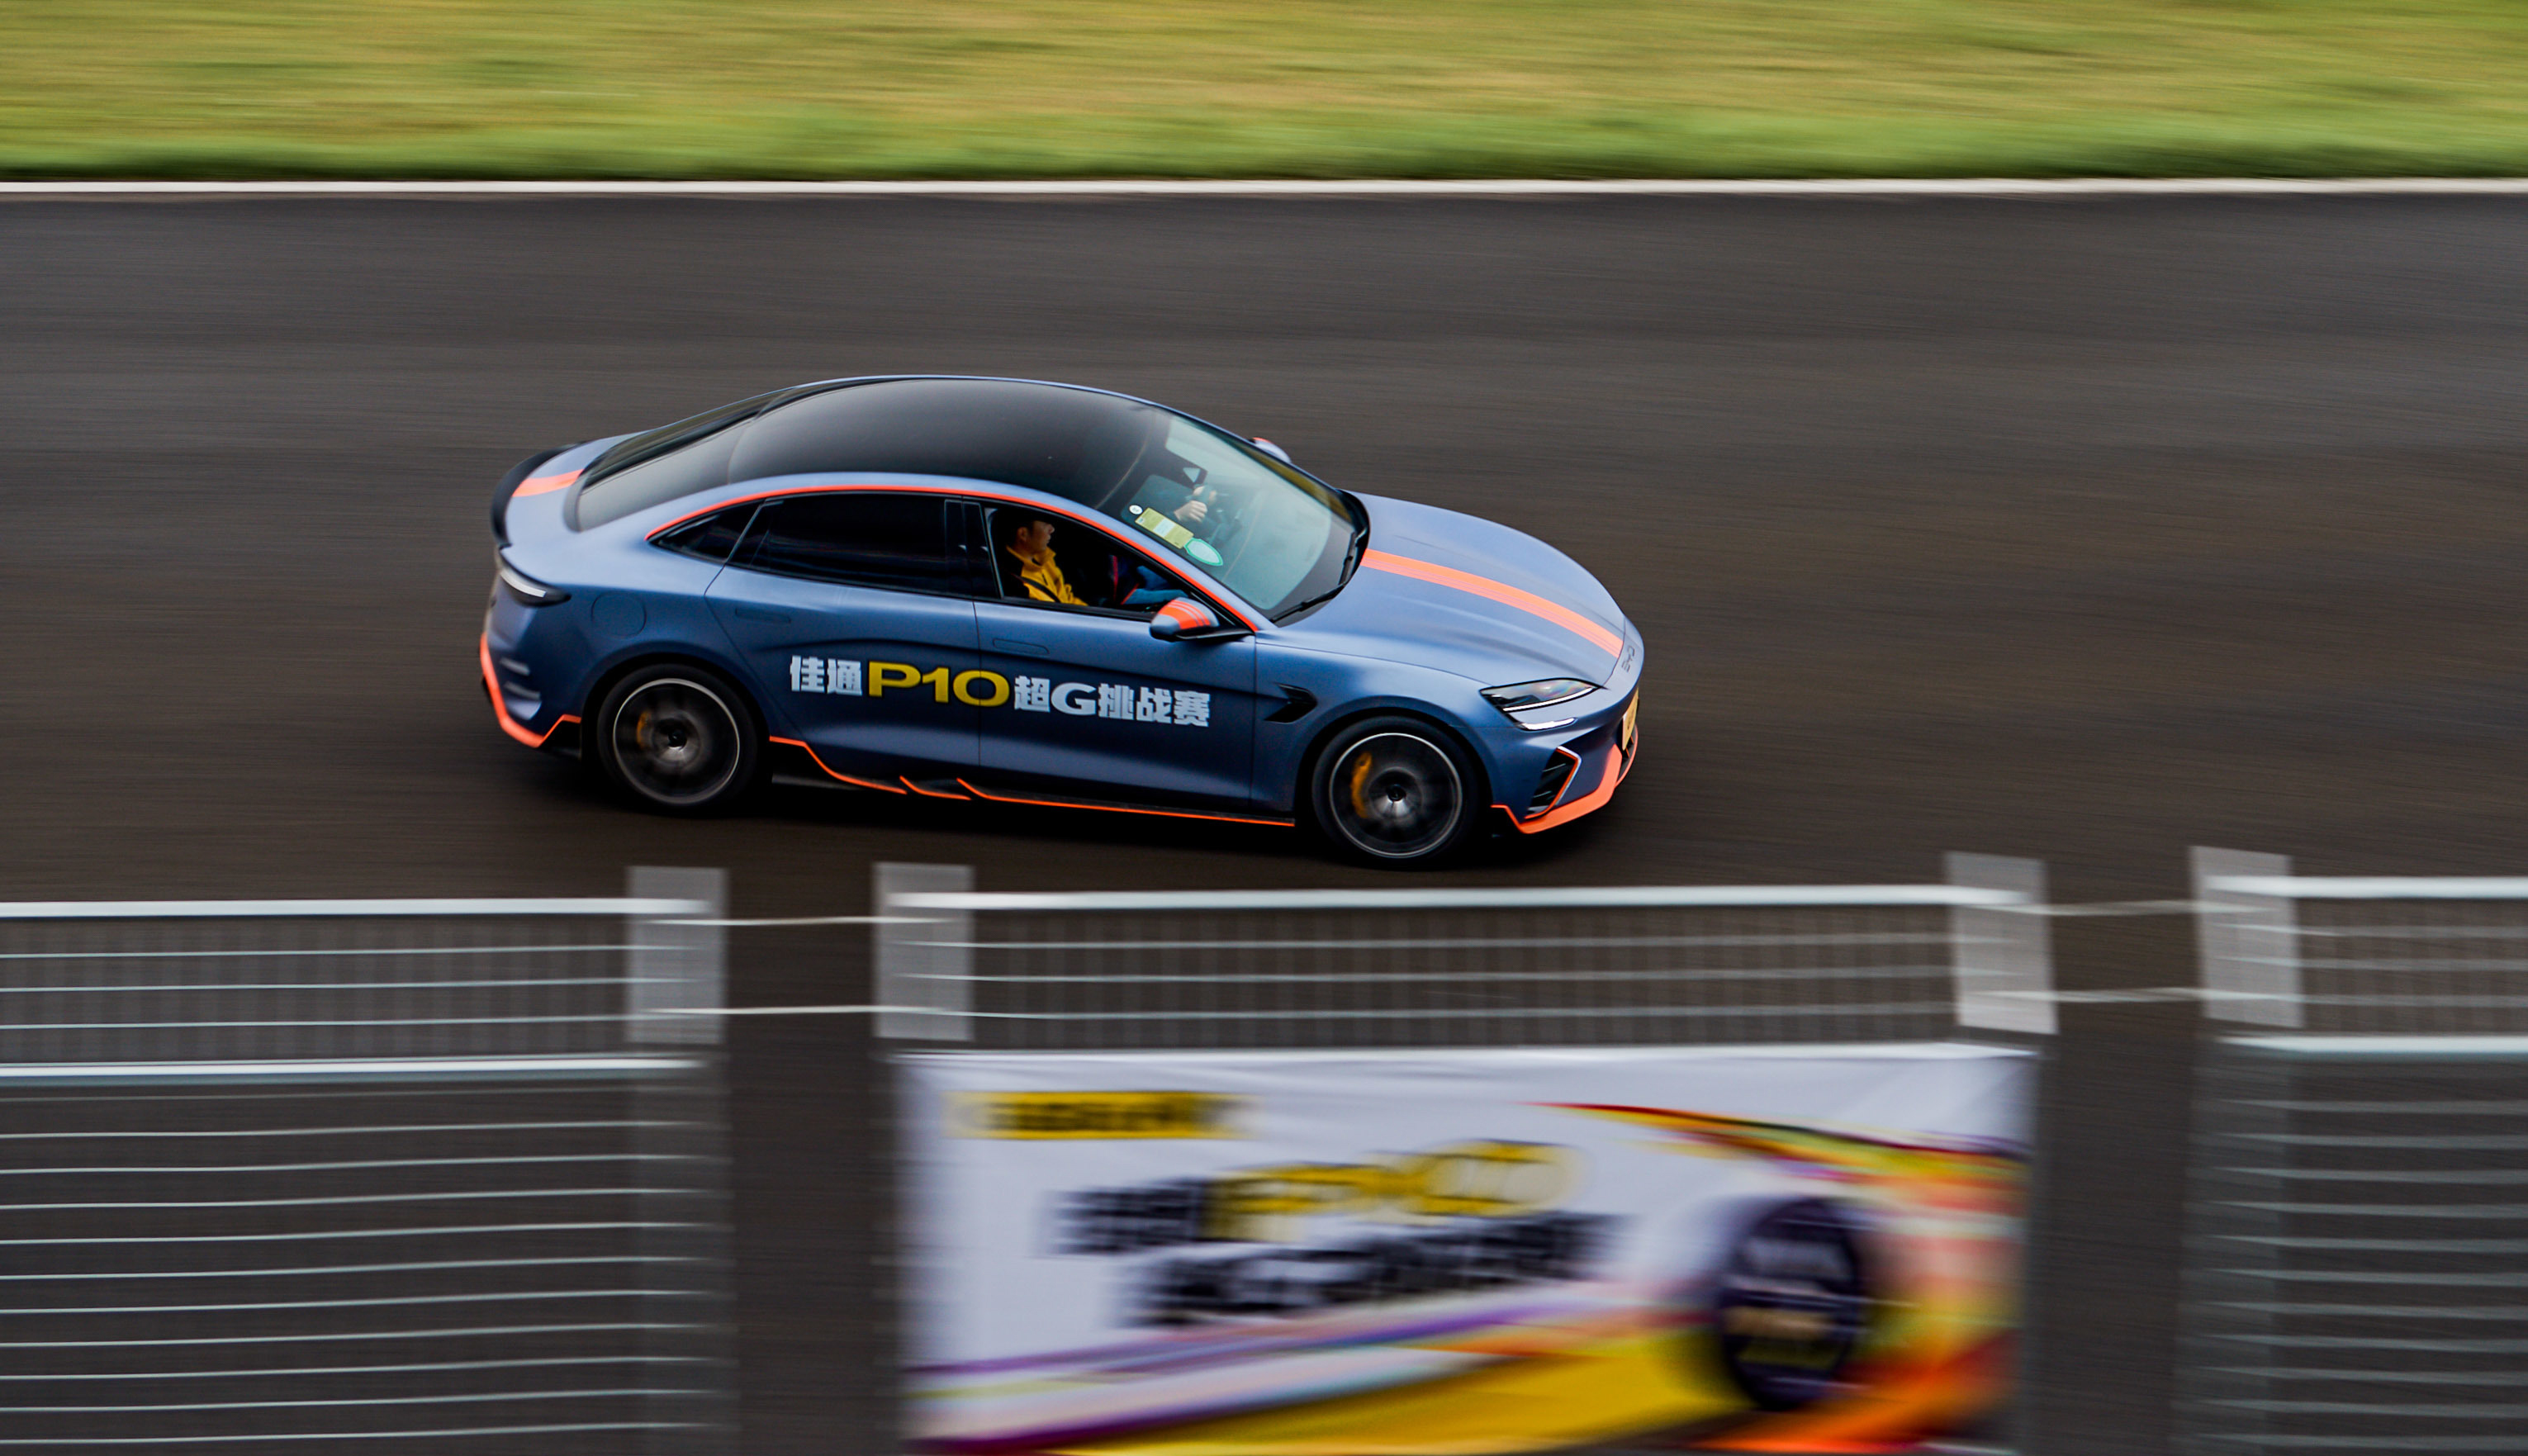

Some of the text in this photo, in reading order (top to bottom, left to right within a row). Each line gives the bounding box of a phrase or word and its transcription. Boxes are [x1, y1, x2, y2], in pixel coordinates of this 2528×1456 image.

[790, 655, 1211, 727] 佳通P10超G挑战赛
